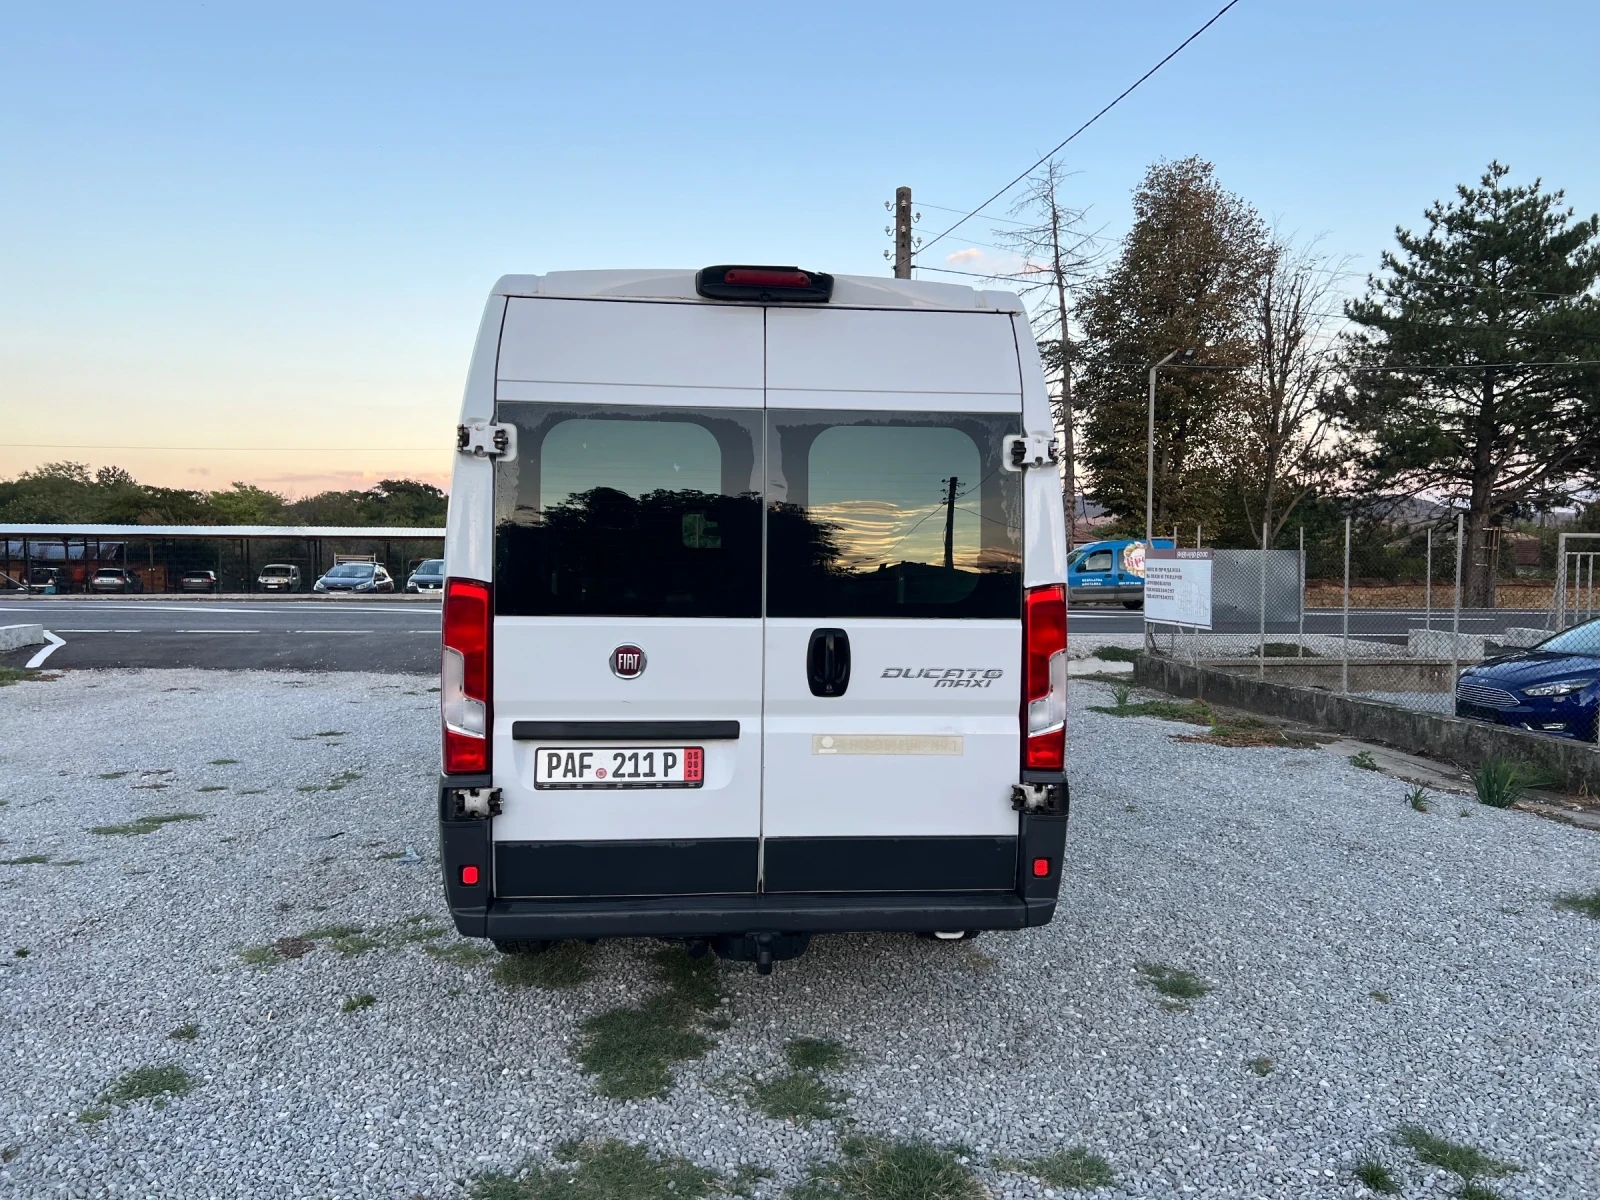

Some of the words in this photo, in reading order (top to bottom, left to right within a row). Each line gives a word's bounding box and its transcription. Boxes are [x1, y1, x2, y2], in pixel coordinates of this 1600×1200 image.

[618, 653, 640, 670] FIAT
[880, 668, 1003, 679] DUCATO
[933, 679, 992, 688] MAXI
[547, 752, 594, 779] PAF
[612, 752, 657, 778] 211
[663, 752, 677, 778] P
